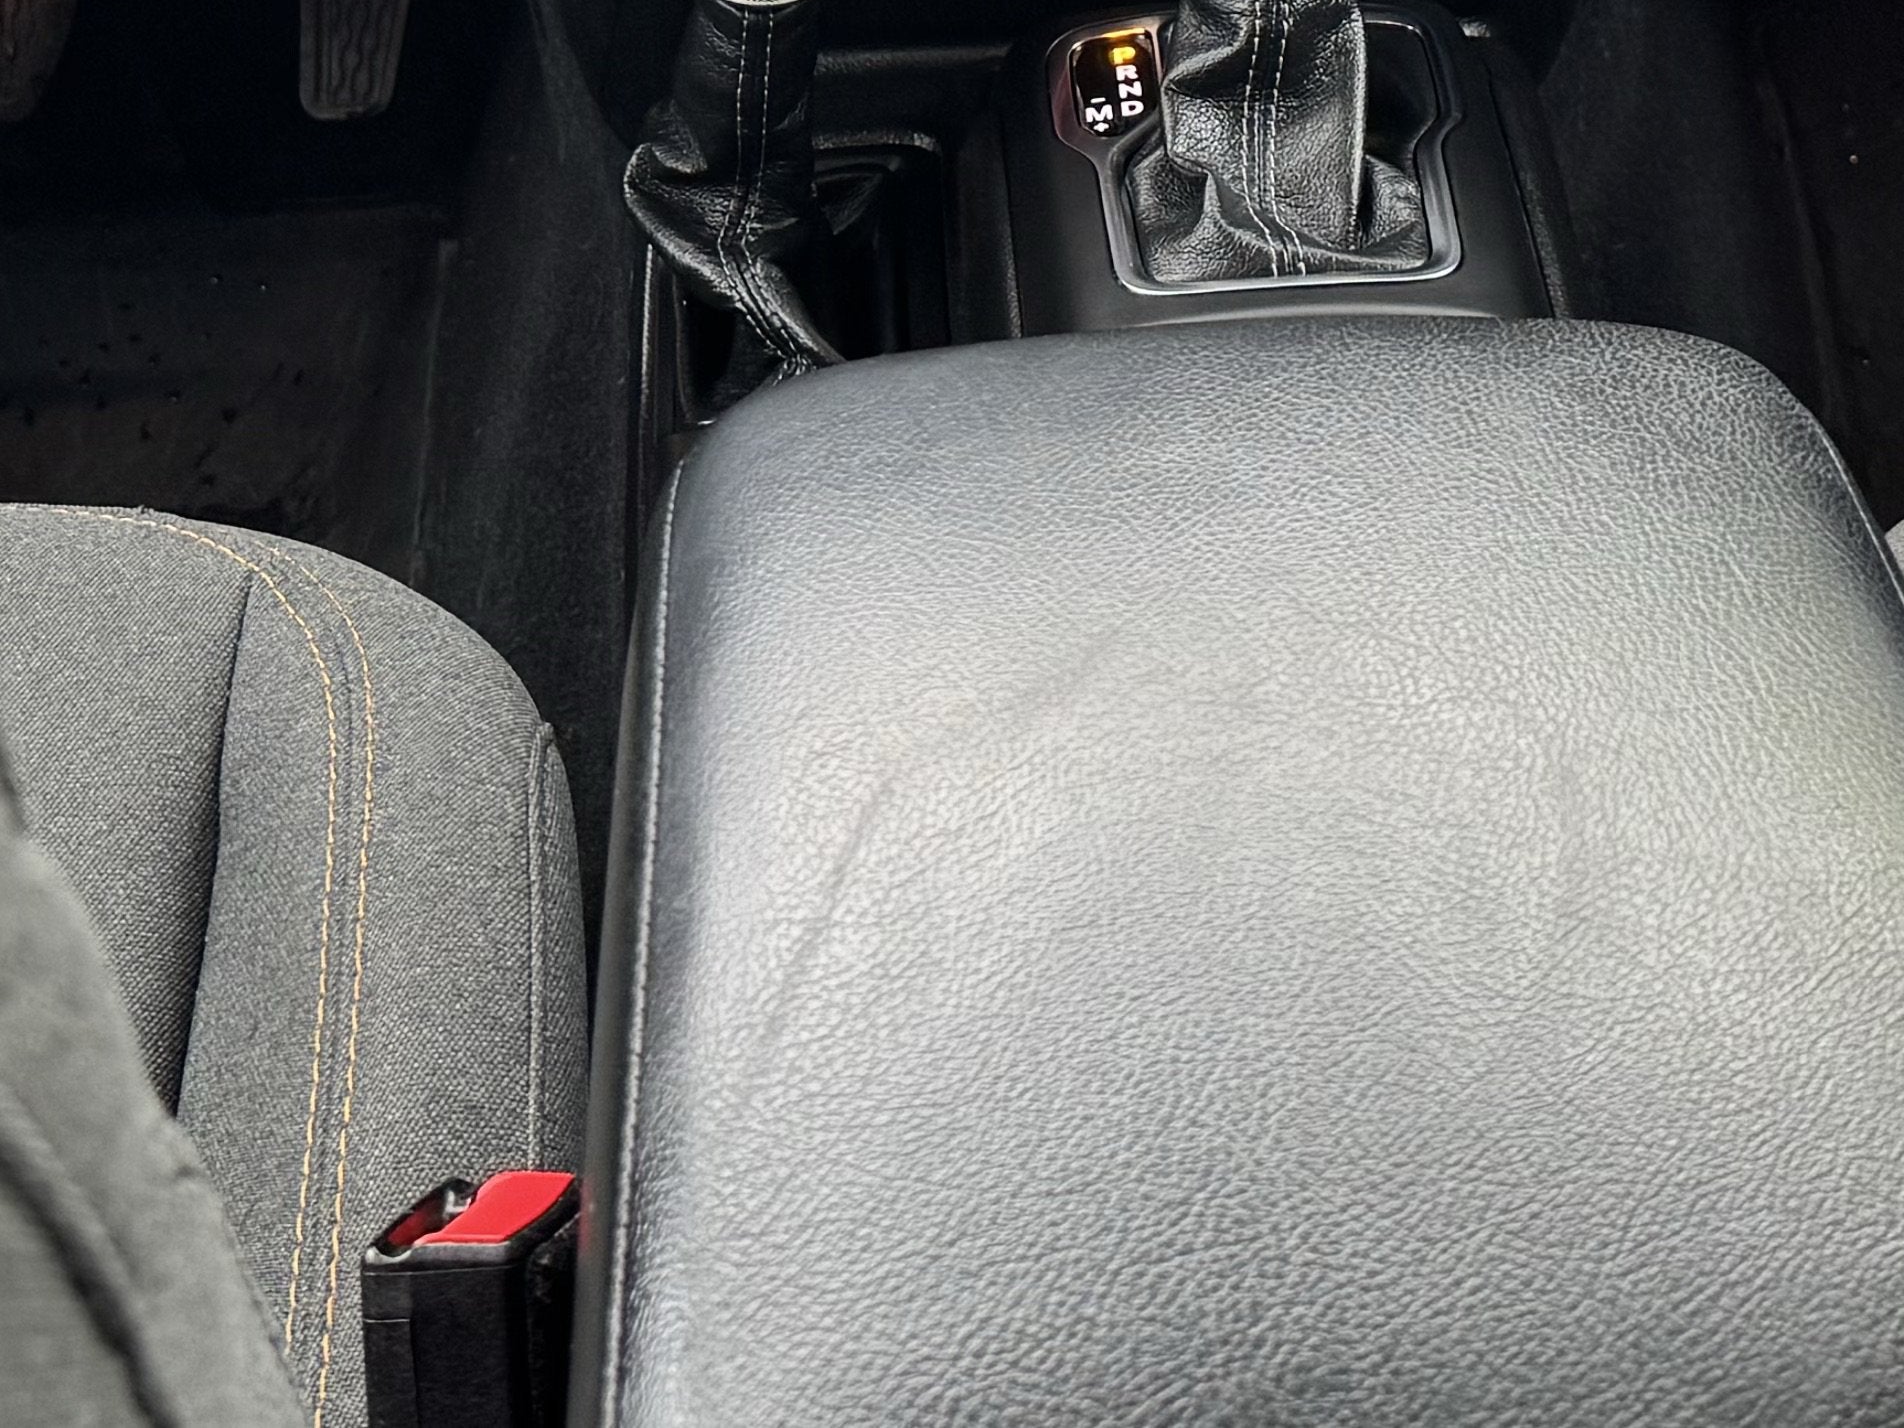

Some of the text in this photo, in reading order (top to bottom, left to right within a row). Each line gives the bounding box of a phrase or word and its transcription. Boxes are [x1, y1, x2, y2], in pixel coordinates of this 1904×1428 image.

[1112, 46, 1136, 65] P
[1116, 64, 1139, 81] R
[1118, 81, 1143, 99] N
[1085, 104, 1114, 123] M
[1120, 100, 1145, 117] D
